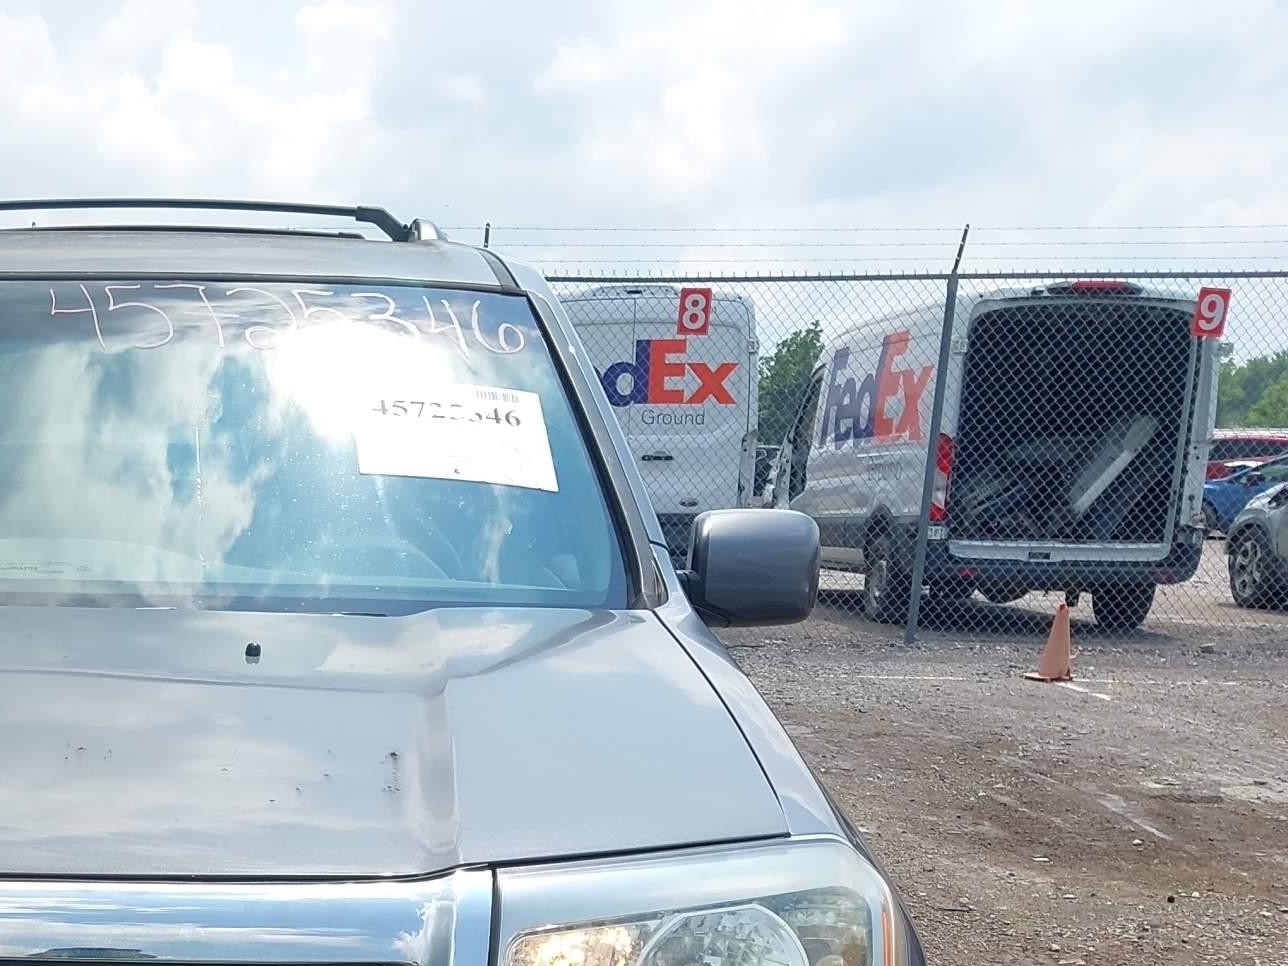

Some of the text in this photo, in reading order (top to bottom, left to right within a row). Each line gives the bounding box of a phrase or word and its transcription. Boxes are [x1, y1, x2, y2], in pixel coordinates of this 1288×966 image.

[682, 293, 706, 330] 8
[1198, 294, 1225, 330] 9
[593, 339, 740, 408] dEx
[818, 329, 935, 450] FedEx
[641, 409, 706, 426] Ground
